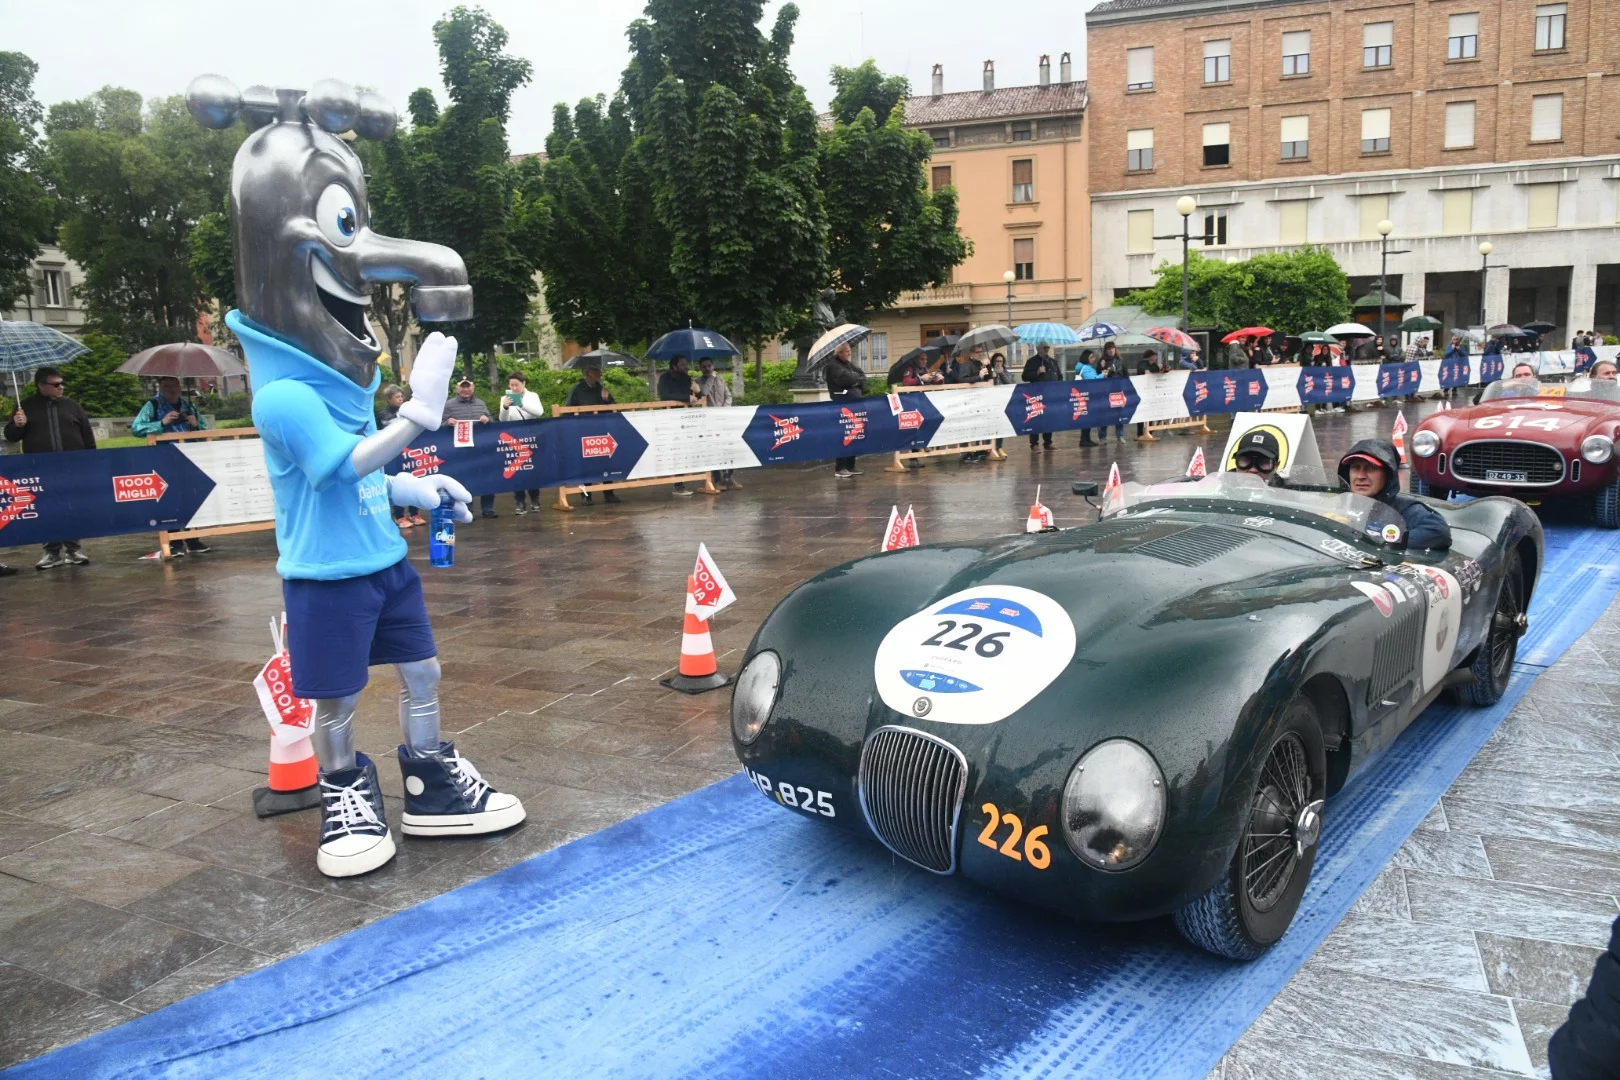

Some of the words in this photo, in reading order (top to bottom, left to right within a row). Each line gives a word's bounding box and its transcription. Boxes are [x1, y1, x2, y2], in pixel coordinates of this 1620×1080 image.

[774, 416, 799, 428] 1000
[1474, 415, 1561, 432] 614
[774, 425, 800, 437] MIGLIA
[585, 438, 609, 446] 1000
[775, 433, 800, 445] 2019
[402, 445, 438, 460] 1000
[496, 443, 539, 452] BEAUTIFUL
[585, 446, 611, 455] MIGLIA
[505, 451, 530, 459] RACE
[402, 455, 439, 471] MIGLIA
[503, 464, 535, 472] WORLD
[119, 477, 153, 488] 1000
[119, 487, 157, 499] MIGLIA
[694, 562, 715, 591] 000
[920, 620, 1011, 659] 226
[267, 668, 296, 714] 1000
[778, 781, 836, 818] 825
[977, 802, 1051, 870] 226
